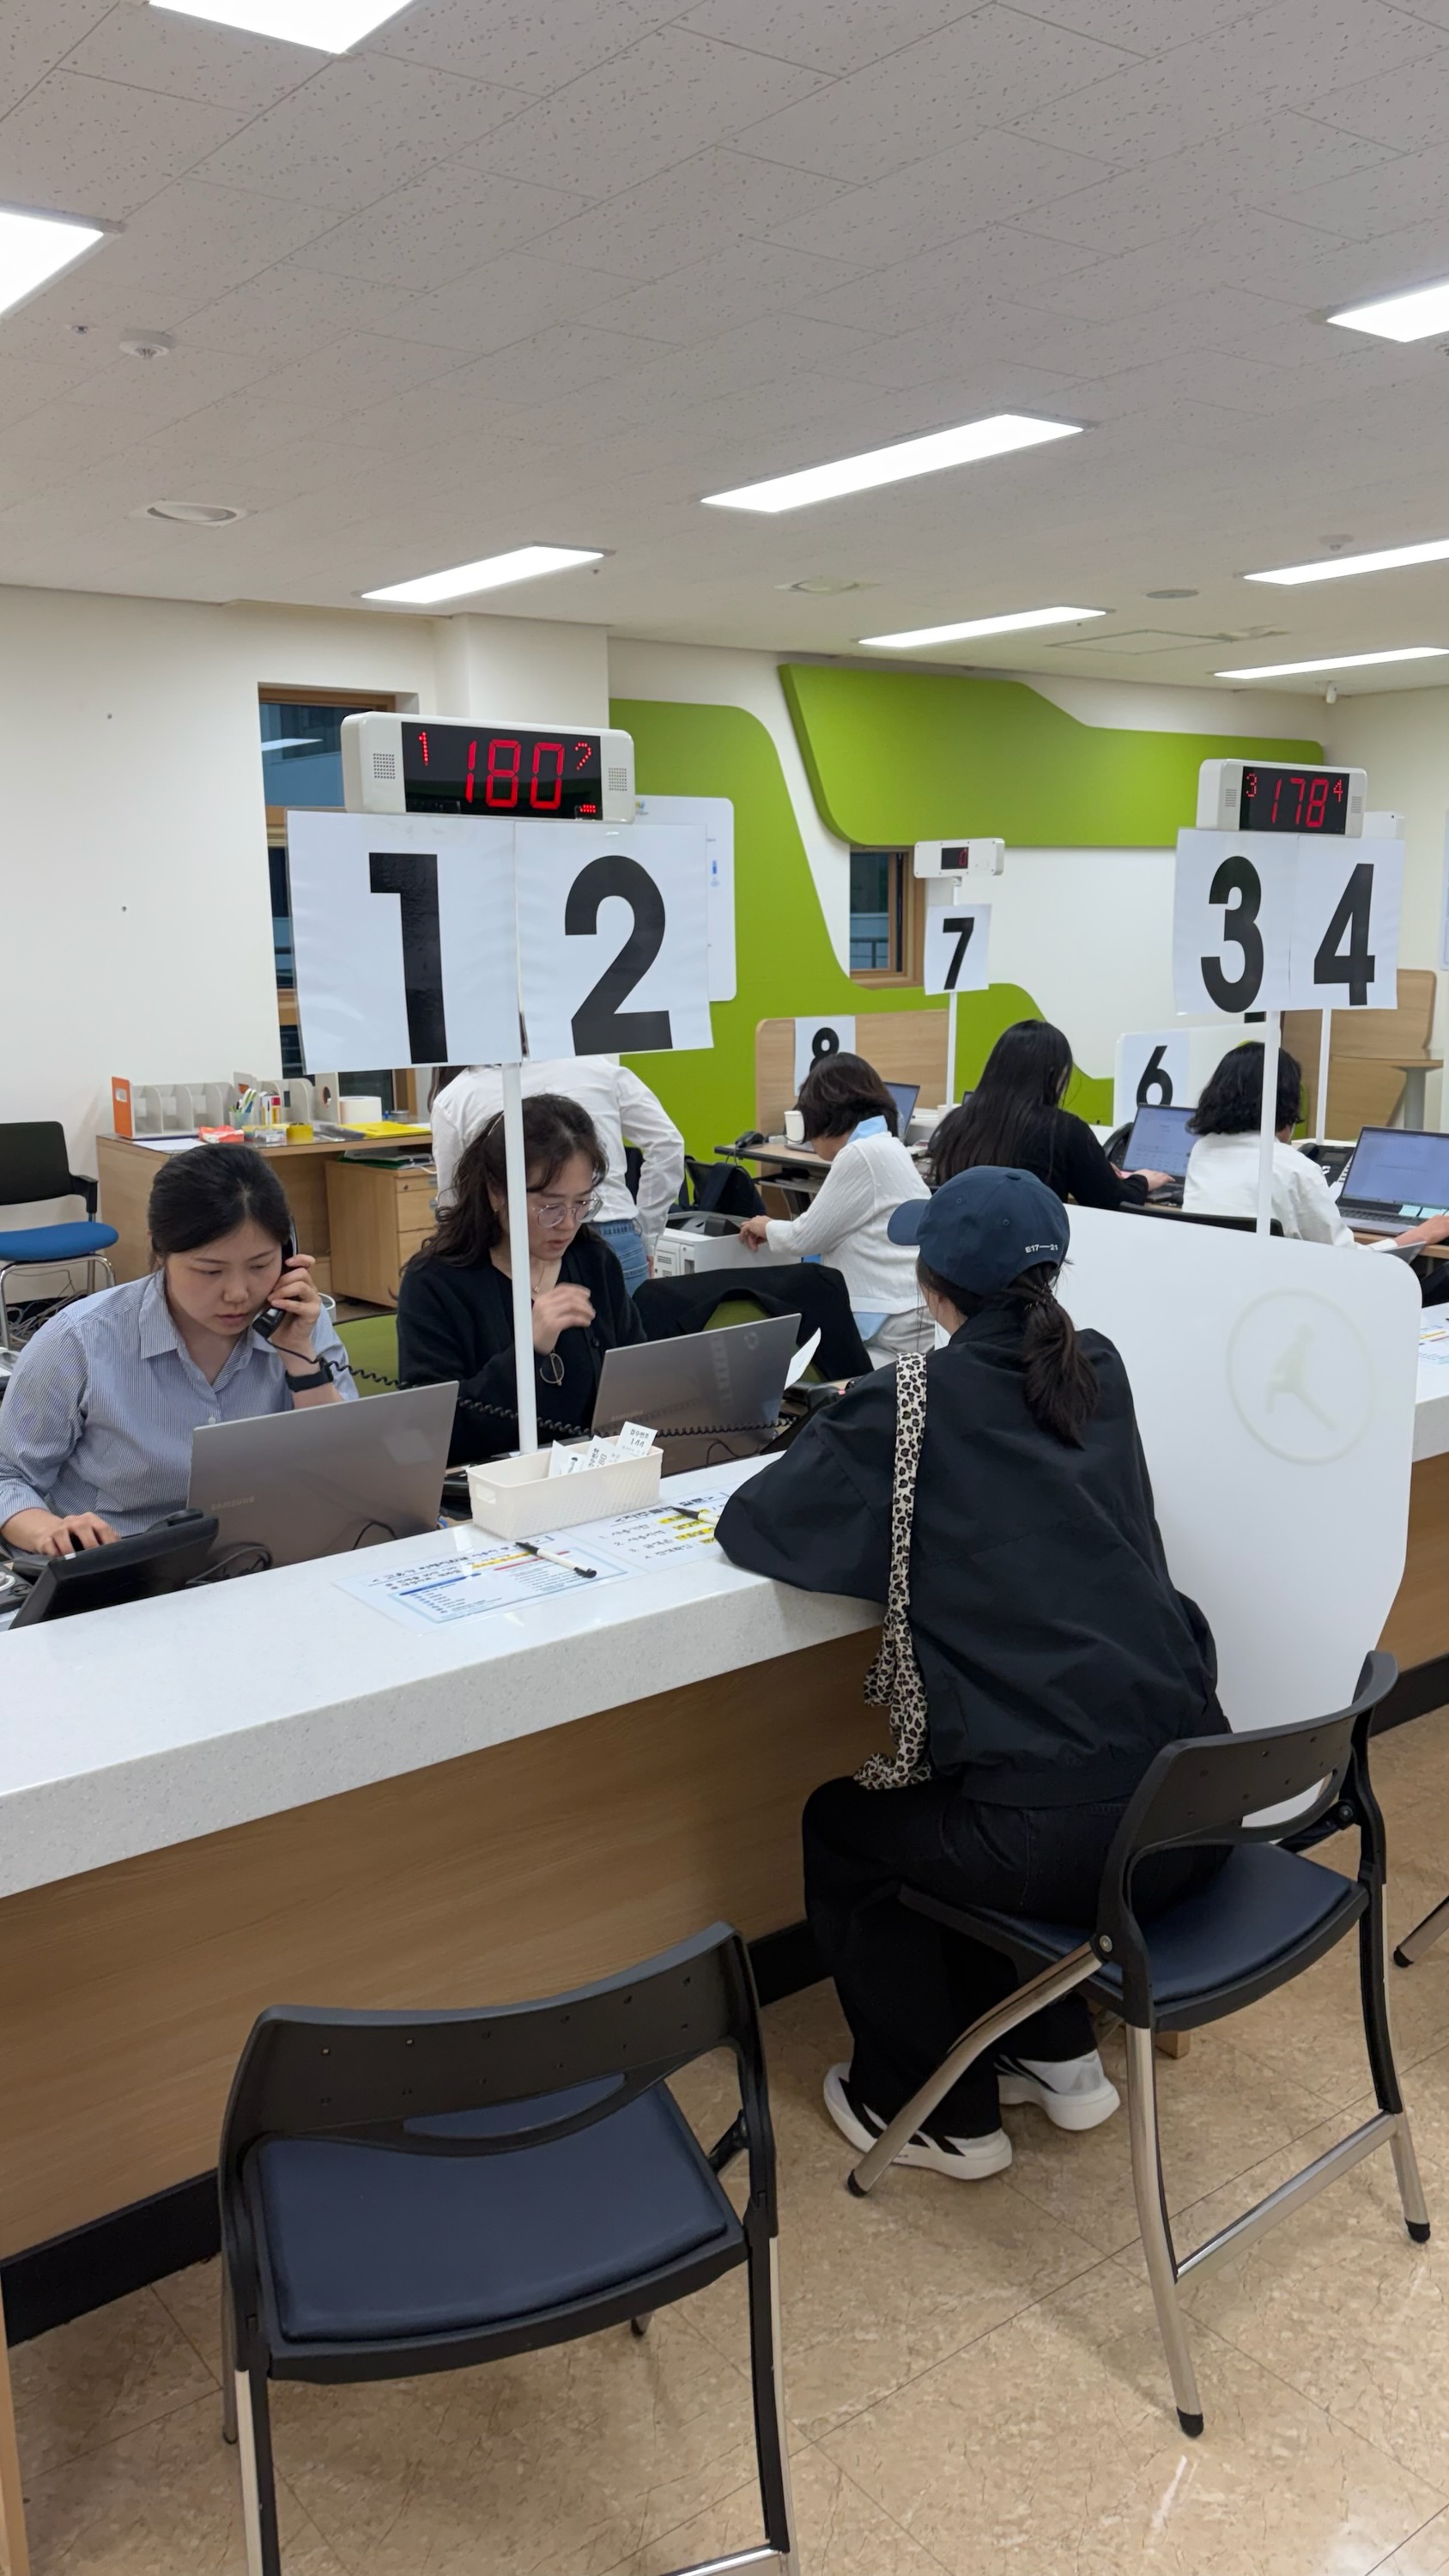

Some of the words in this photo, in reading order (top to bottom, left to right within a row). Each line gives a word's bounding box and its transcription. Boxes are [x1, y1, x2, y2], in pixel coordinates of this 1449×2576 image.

[418, 732, 428, 766] 1
[464, 738, 566, 810] 180
[1246, 773, 1258, 798] 3
[1271, 777, 1330, 828] 178
[1333, 779, 1343, 802] 4
[368, 852, 448, 1065] 1
[565, 854, 673, 1056] 2
[943, 916, 975, 990] 7
[1201, 855, 1264, 1013] 3
[1313, 863, 1376, 1006] 4
[1136, 1044, 1173, 1106] 6
